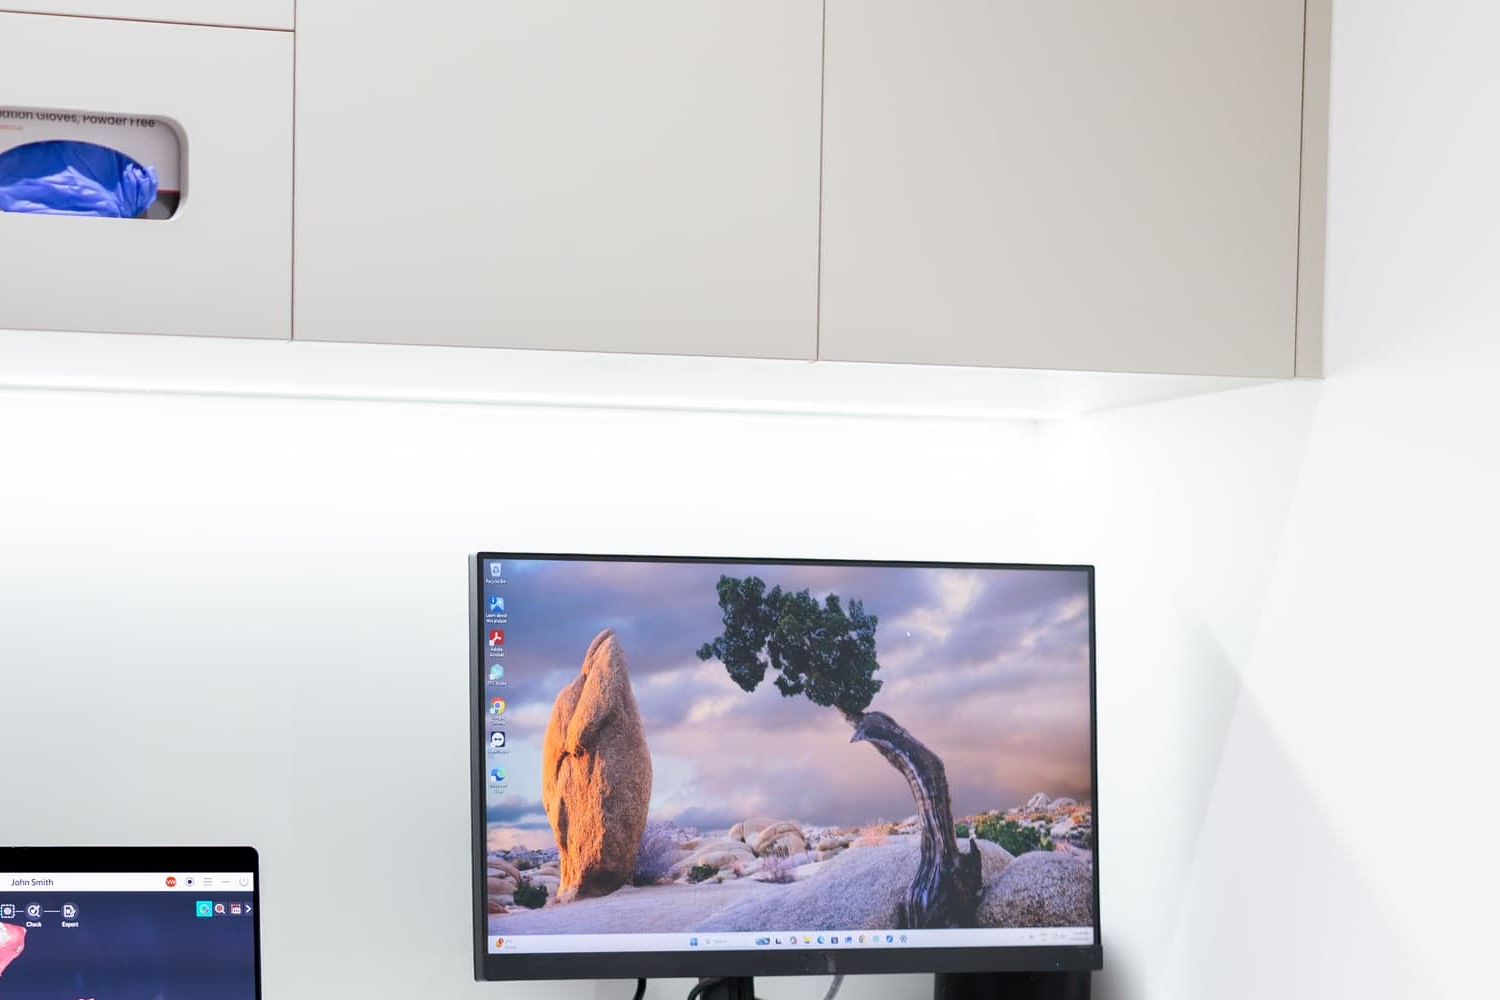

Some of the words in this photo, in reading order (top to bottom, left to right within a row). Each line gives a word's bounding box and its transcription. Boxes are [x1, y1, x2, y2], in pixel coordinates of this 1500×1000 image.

[83, 114, 127, 126] Powder
[130, 117, 156, 128] Free
[11, 878, 30, 886] John
[31, 878, 54, 886] Smith
[61, 921, 79, 929] Export
